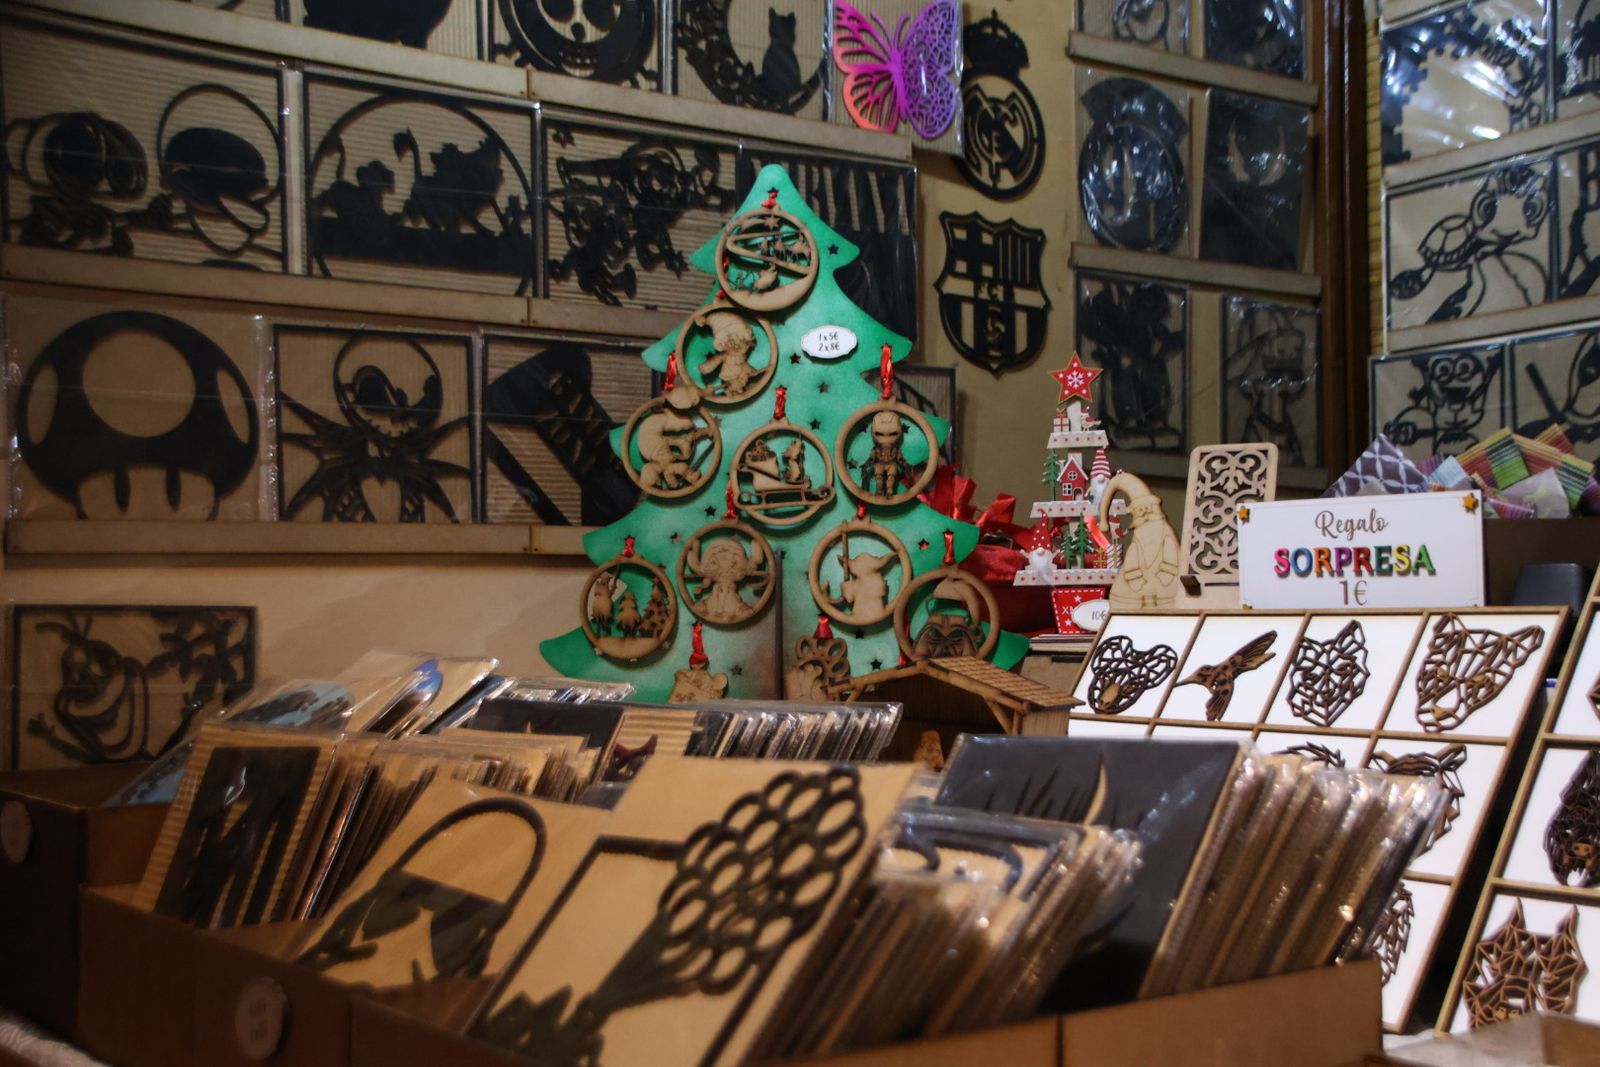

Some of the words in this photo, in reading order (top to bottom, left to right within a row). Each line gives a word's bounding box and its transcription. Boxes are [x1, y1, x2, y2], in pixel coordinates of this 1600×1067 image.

[1314, 508, 1389, 541] Regalo
[1274, 544, 1436, 578] SORPRESA
[1339, 580, 1368, 606] 1€
